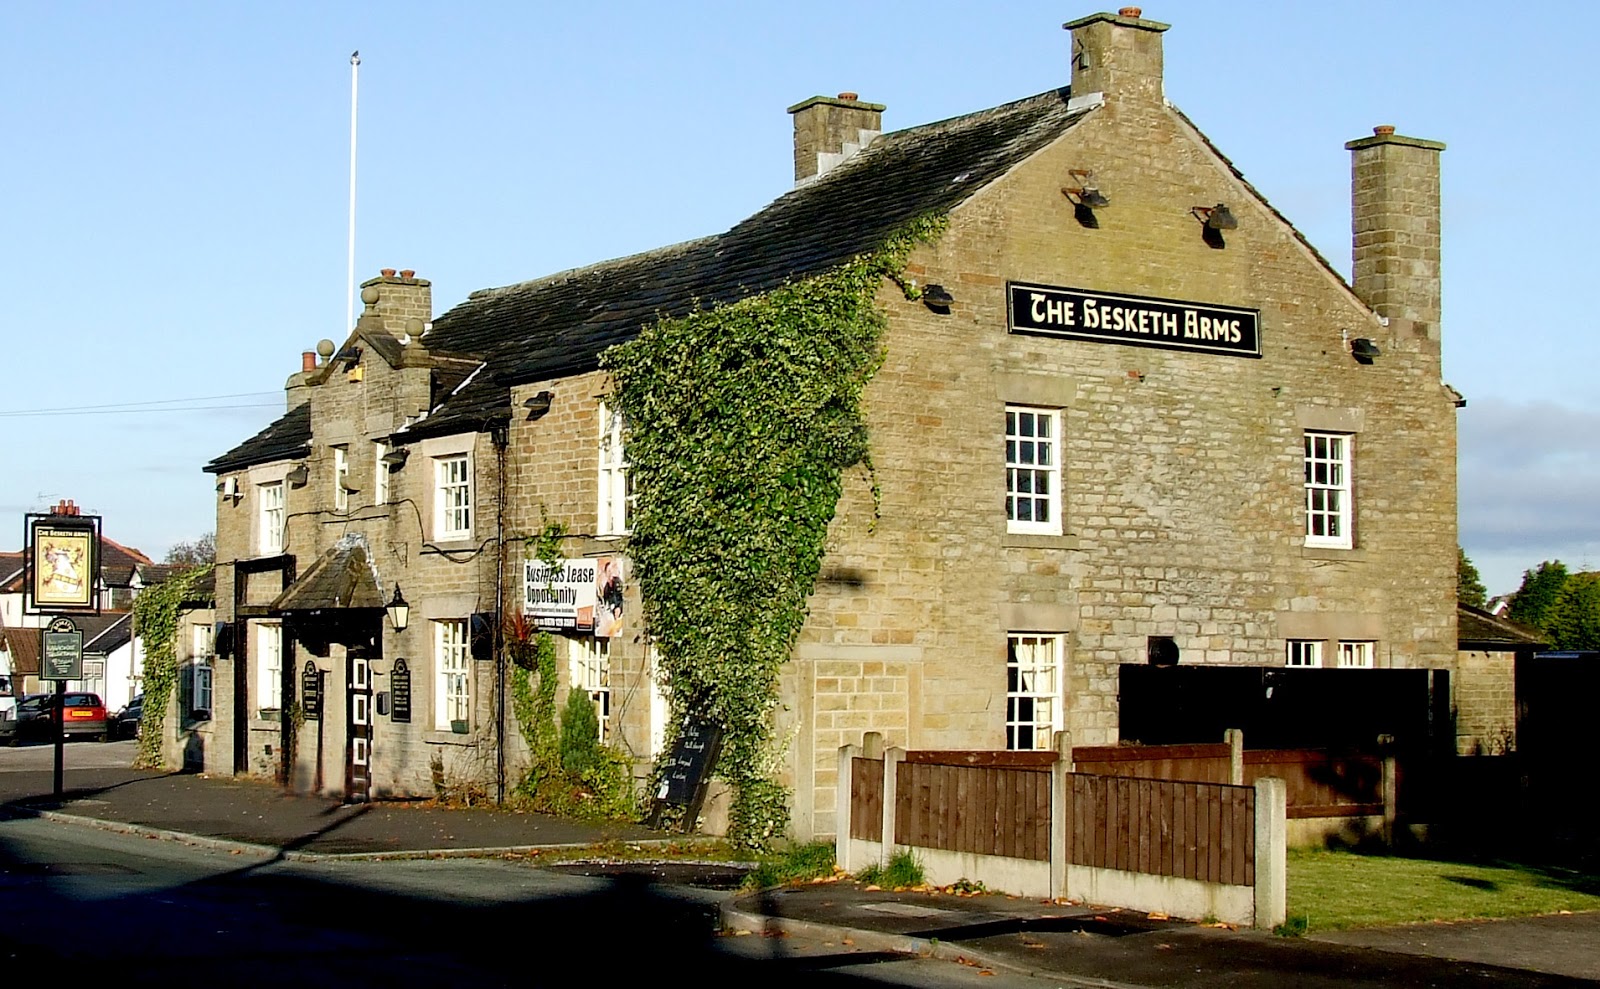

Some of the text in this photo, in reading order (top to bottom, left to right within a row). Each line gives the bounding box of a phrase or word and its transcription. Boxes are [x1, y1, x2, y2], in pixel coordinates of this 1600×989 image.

[1030, 293, 1242, 343] THE HESKETH ARMS
[566, 565, 595, 583] Lease
